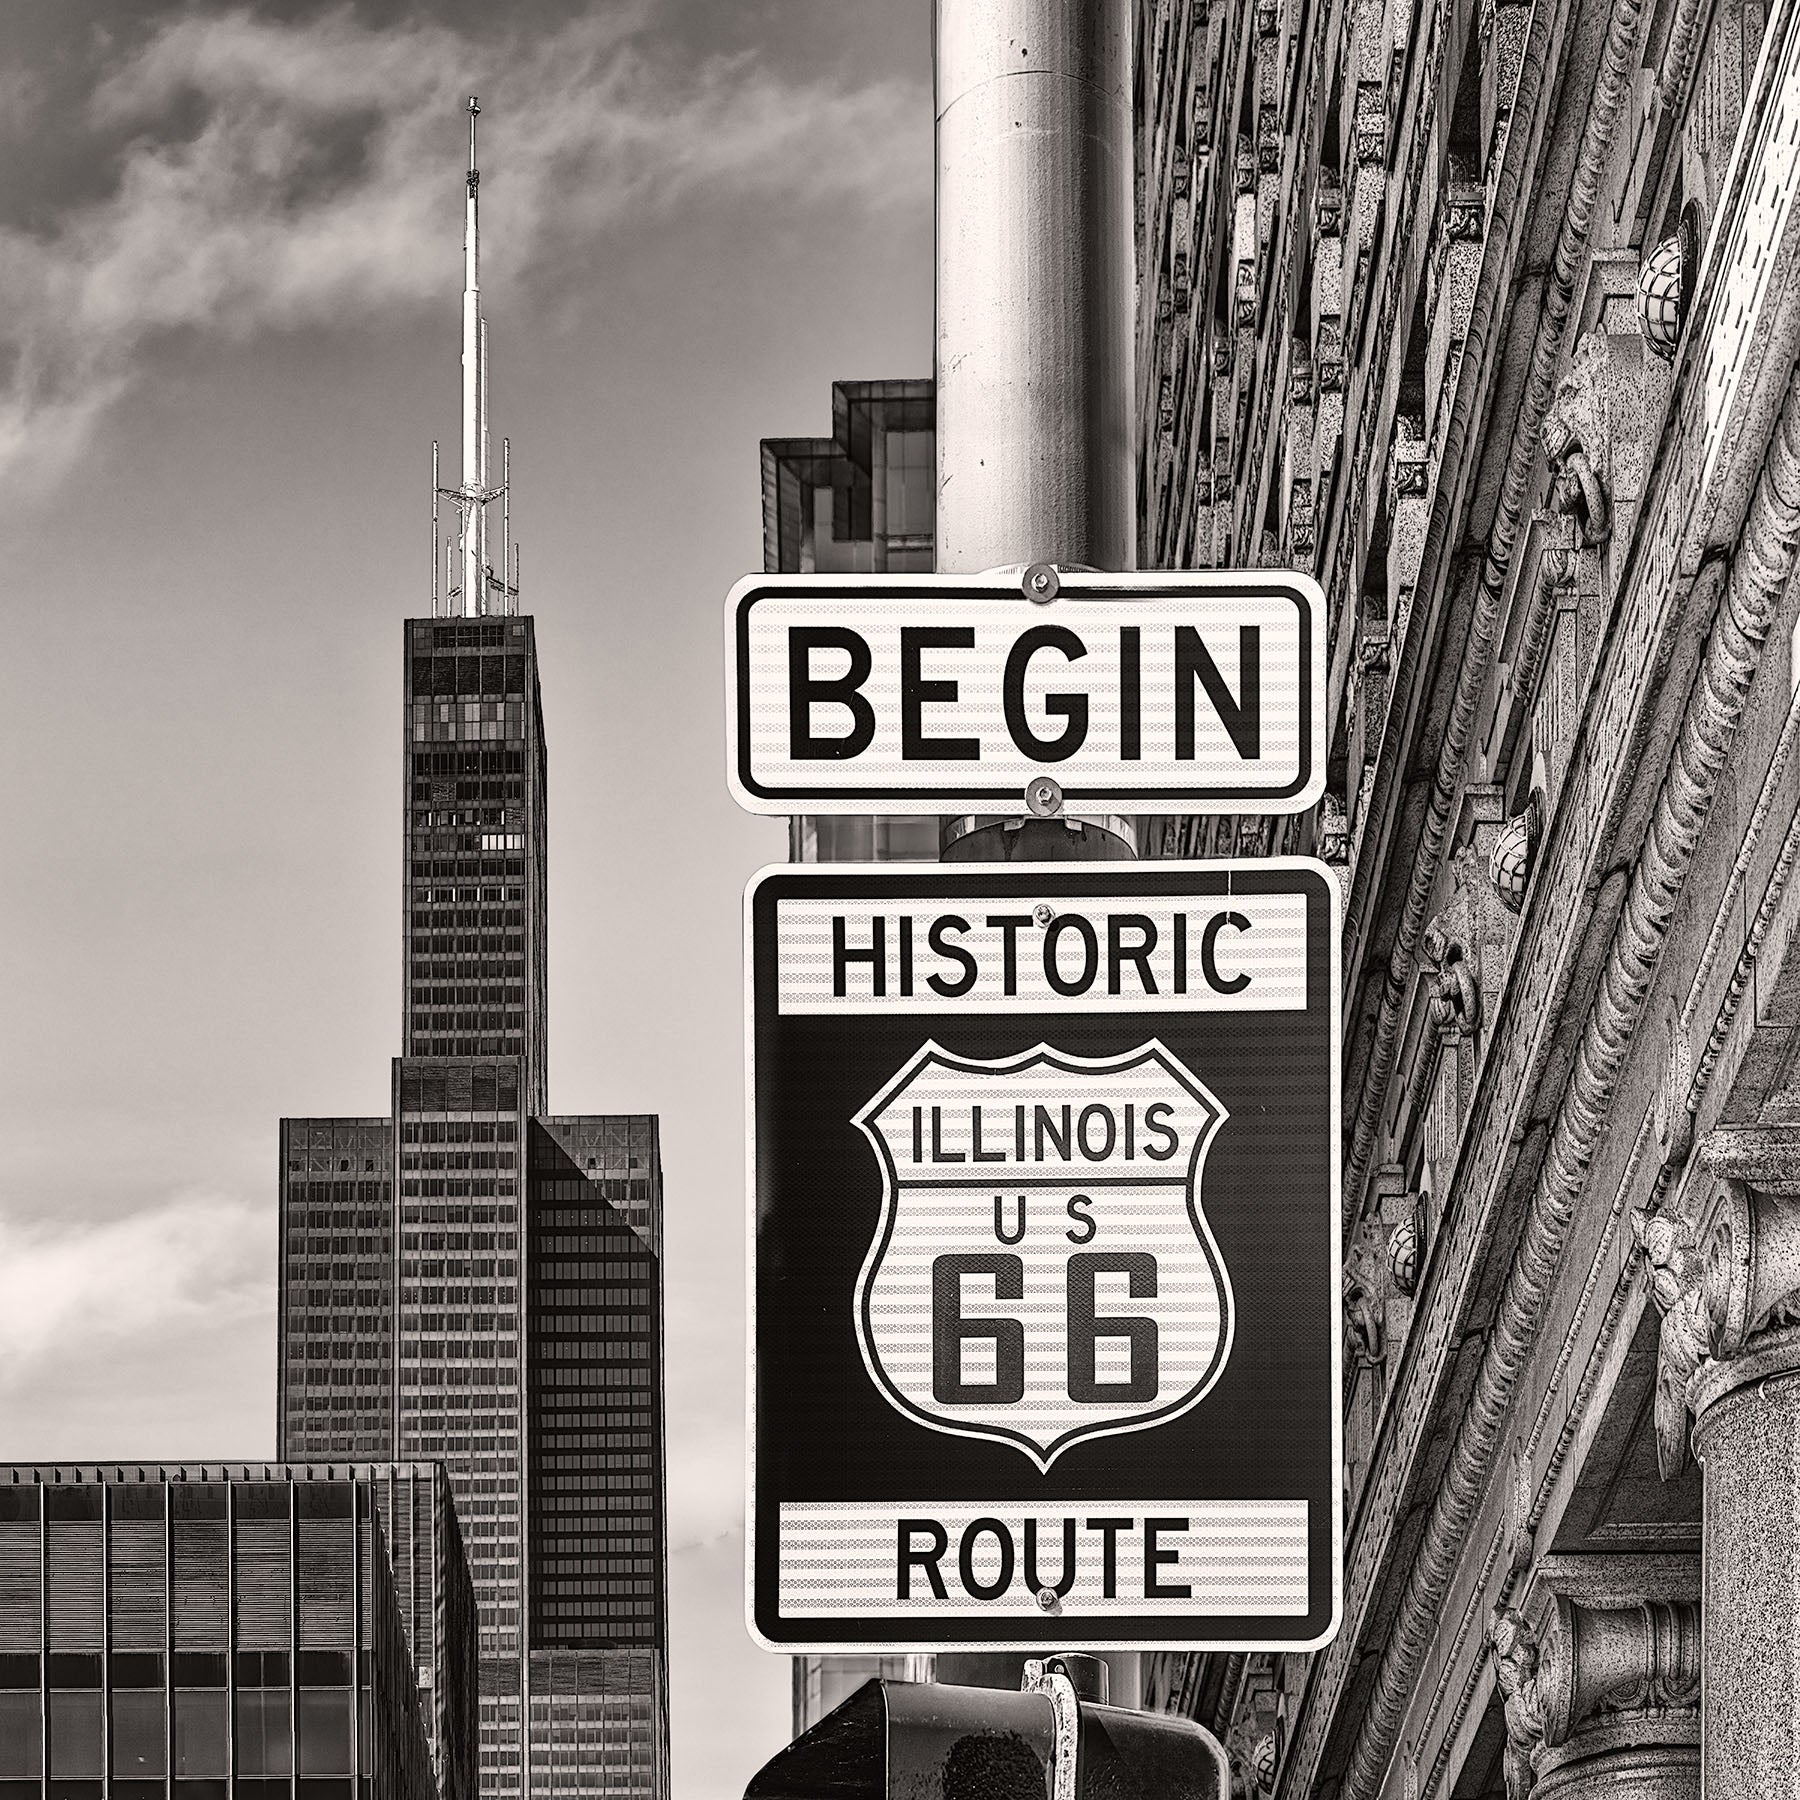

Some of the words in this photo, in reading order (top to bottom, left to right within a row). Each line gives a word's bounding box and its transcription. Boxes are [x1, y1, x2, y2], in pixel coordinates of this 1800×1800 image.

[788, 625, 1261, 763] BEGIN
[832, 911, 1252, 998] HISTORIC
[912, 1102, 1179, 1163] ILLINOIS
[932, 1252, 1159, 1405] 66
[896, 1517, 1192, 1601] ROUTE
